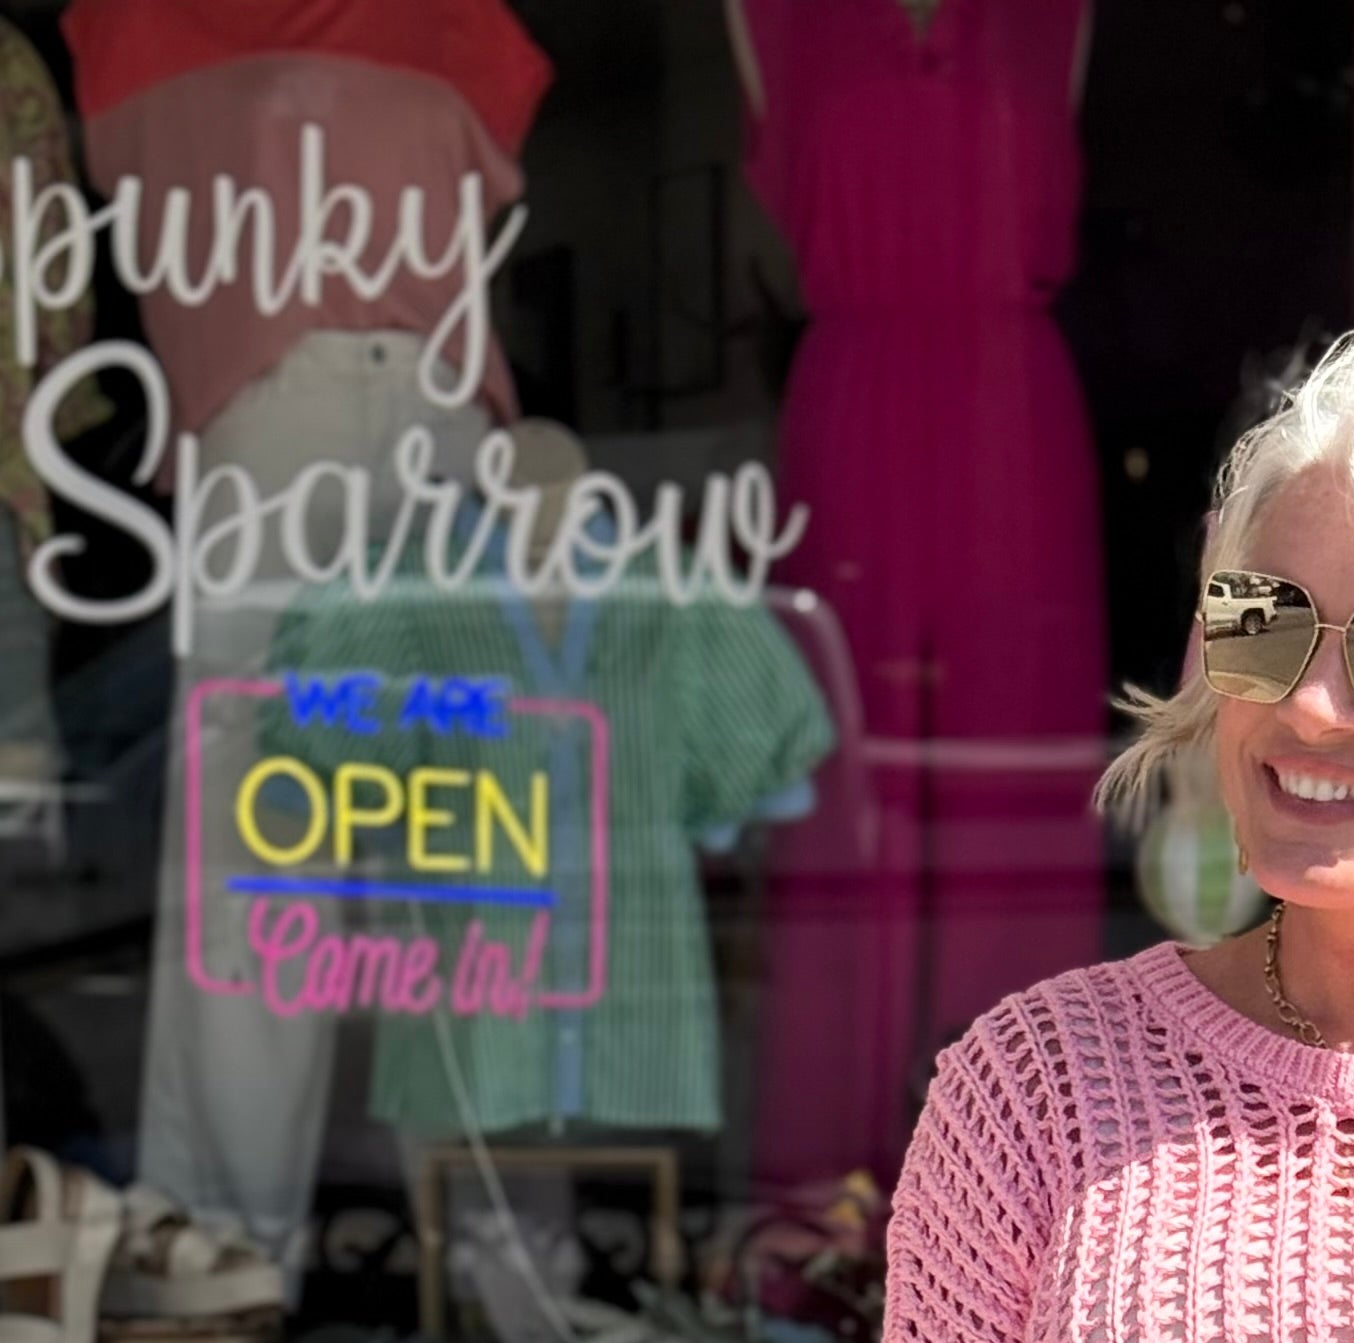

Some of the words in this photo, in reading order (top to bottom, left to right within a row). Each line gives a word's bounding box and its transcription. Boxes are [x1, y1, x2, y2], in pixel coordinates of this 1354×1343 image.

[0, 123, 528, 407] punky
[23, 340, 809, 658] Sparrow
[283, 669, 381, 735] WE
[401, 672, 511, 740] ARE
[236, 755, 548, 878] OPEN
[247, 897, 442, 1018] Come
[452, 910, 551, 1023] in!
